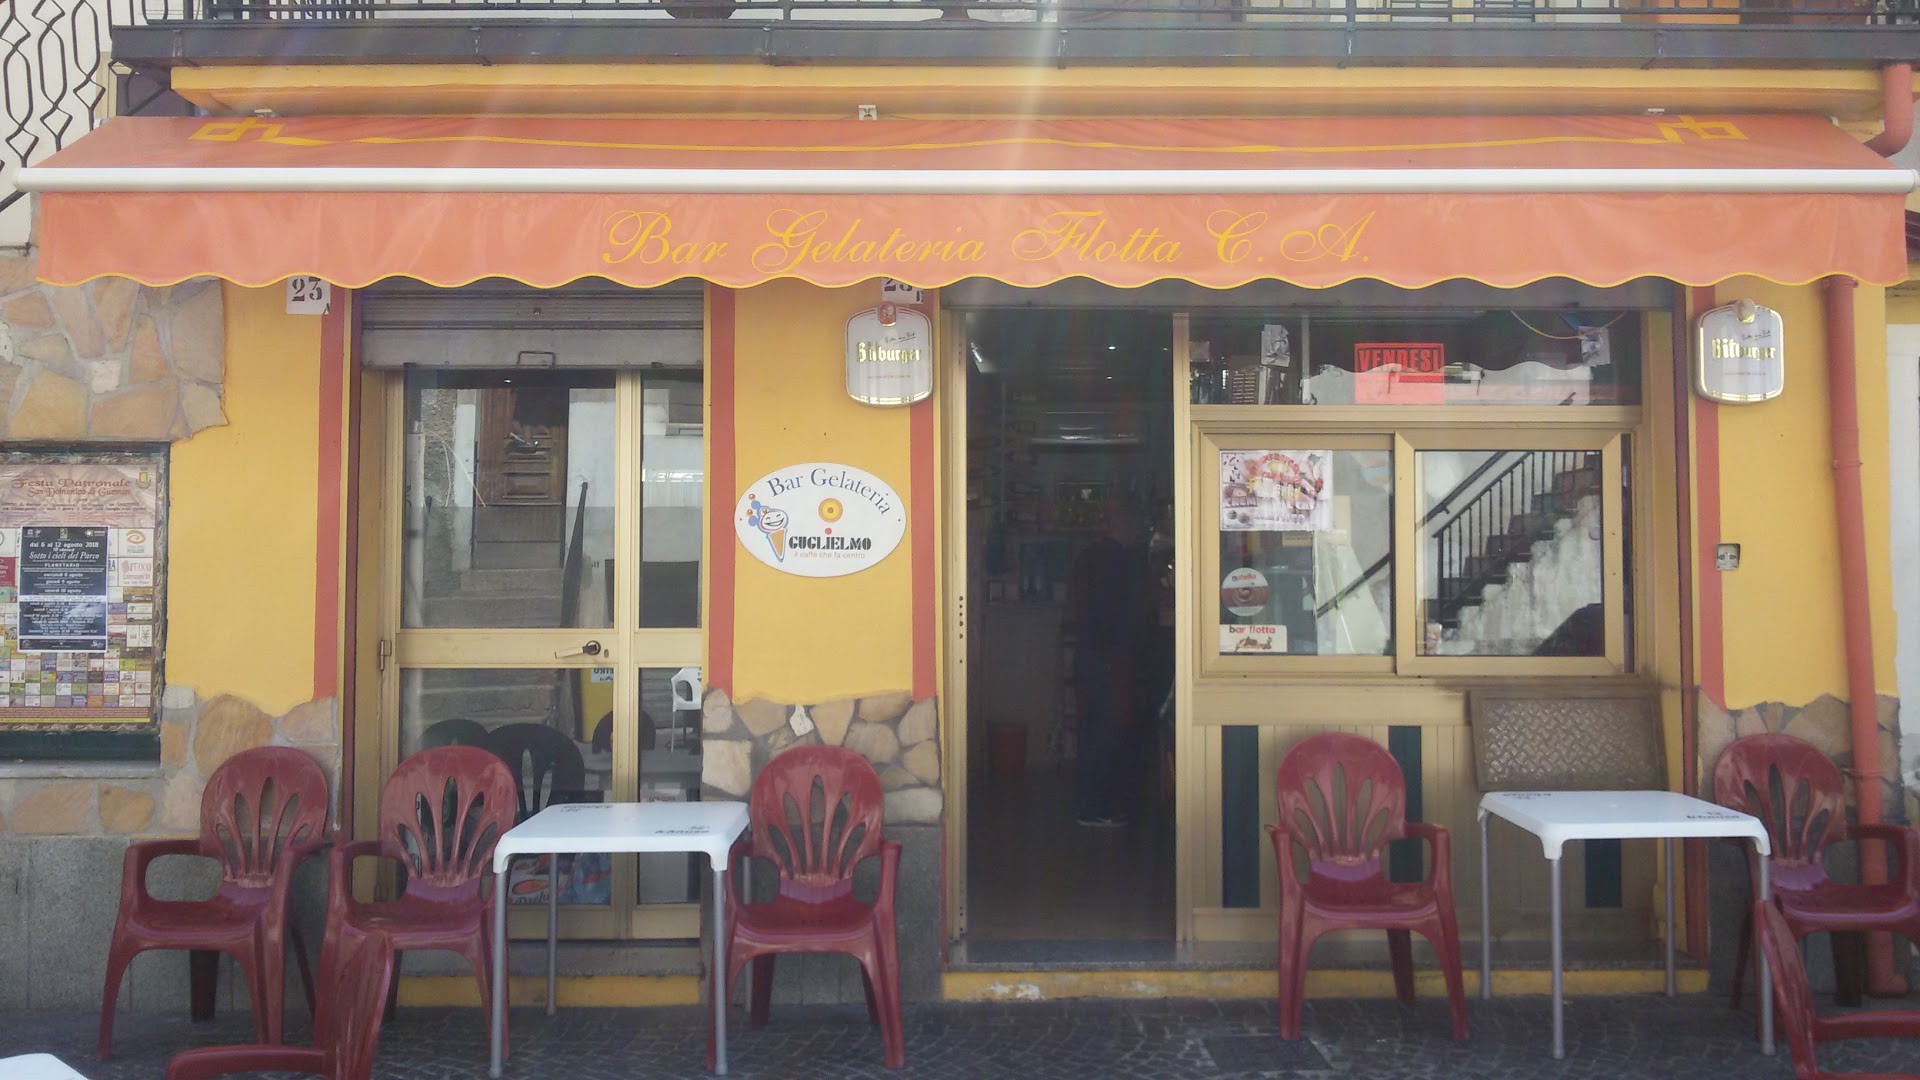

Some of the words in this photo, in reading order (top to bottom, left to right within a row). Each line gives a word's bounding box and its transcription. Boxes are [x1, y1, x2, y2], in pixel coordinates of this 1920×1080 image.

[602, 209, 728, 265] Bar
[751, 208, 988, 274] Gelateria
[1011, 210, 1184, 263] Flotta
[291, 276, 323, 302] 23
[857, 341, 921, 364] Bitburger
[1711, 337, 1777, 361] Bitburger
[1358, 348, 1439, 372] VENDESI
[11, 478, 54, 489] Festa
[58, 478, 132, 488] Patronale
[767, 475, 804, 497] Bar
[810, 467, 891, 516] Gelateria
[63, 541, 83, 549] agosto
[788, 536, 872, 551] GUGLIELMO
[29, 551, 46, 560] Sotto
[67, 551, 78, 560] del
[80, 551, 100, 560] Parco
[819, 551, 832, 559] che
[842, 551, 866, 560] centro
[1231, 573, 1257, 582] nutella
[1229, 624, 1246, 634] bar
[1249, 624, 1276, 634] flotta
